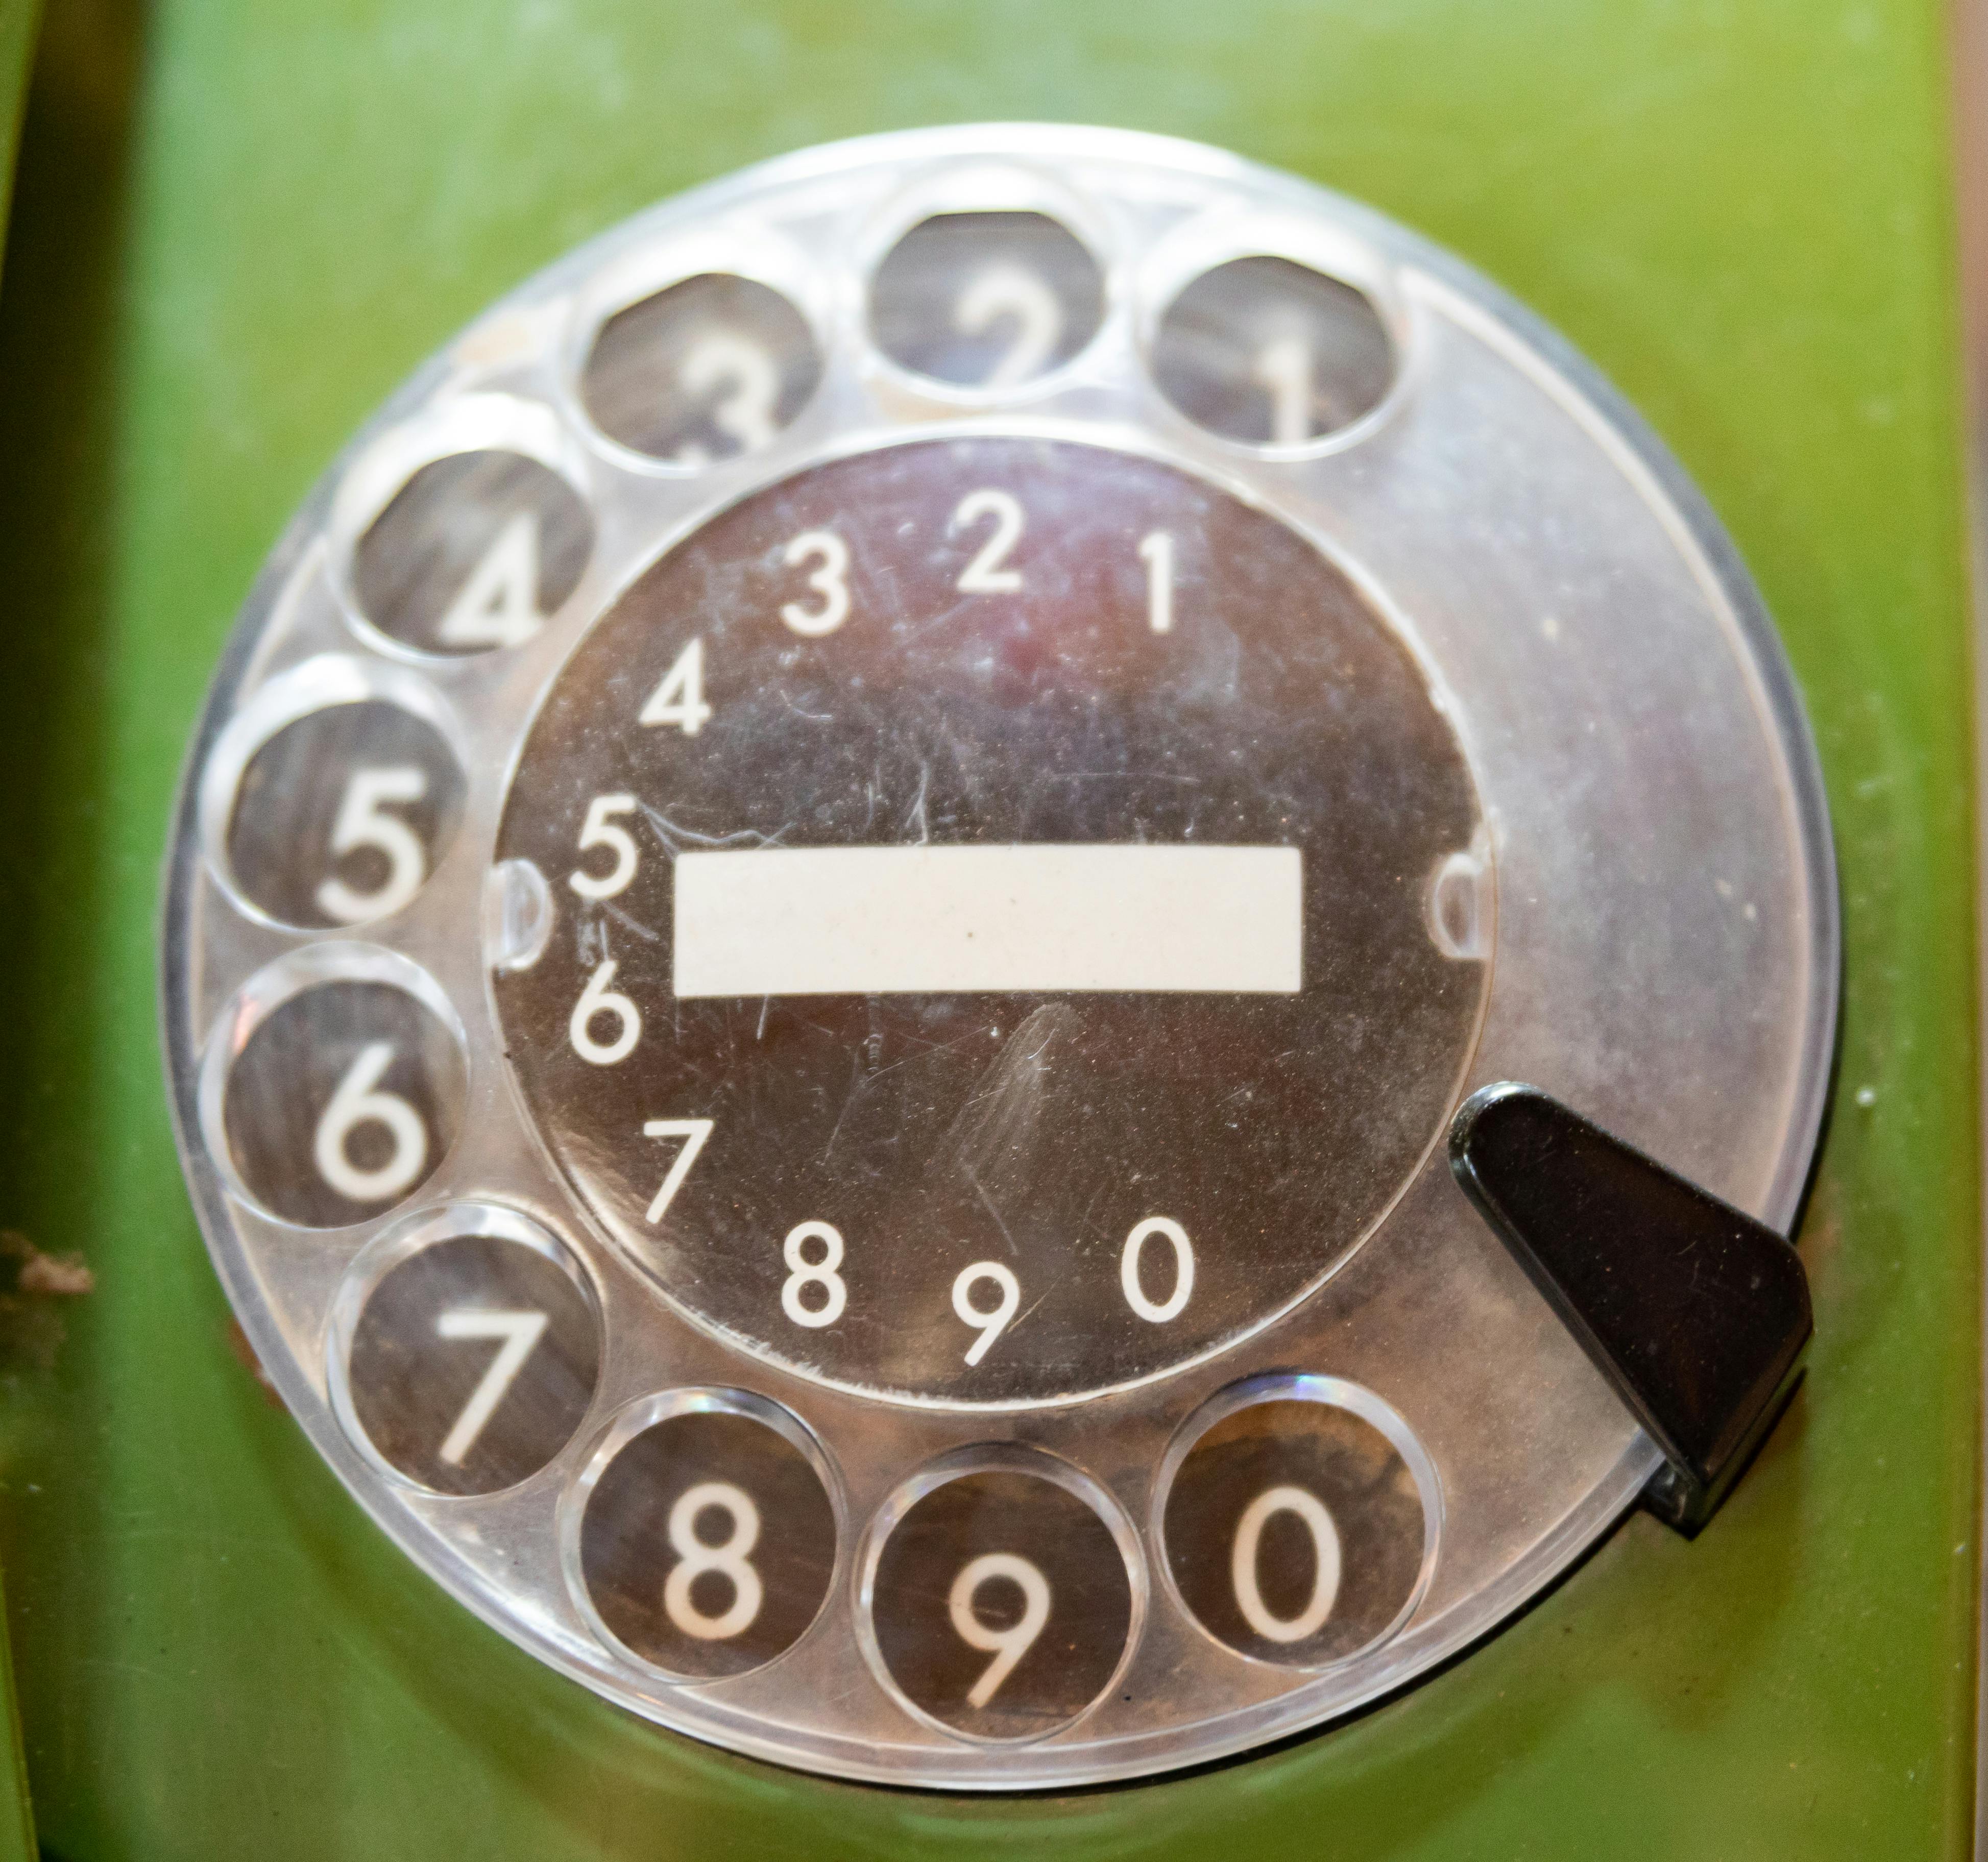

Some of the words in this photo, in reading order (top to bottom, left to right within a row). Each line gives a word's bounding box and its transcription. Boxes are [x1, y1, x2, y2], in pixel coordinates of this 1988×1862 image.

[953, 264, 1063, 387] 2
[1258, 323, 1312, 442] 1
[679, 332, 779, 464] 3
[440, 519, 546, 643] 4
[781, 532, 851, 635] 3
[952, 490, 1025, 594] 2
[1138, 529, 1178, 632] 1
[639, 638, 711, 735] 4
[317, 768, 426, 923] 5
[570, 793, 639, 902] 5
[569, 955, 641, 1064] 6
[313, 1041, 425, 1199] 6
[644, 1119, 715, 1227] 7
[781, 1221, 847, 1329] 8
[951, 1261, 1020, 1366] 9
[1120, 1217, 1197, 1324] 0
[434, 1308, 548, 1464] 7
[665, 1482, 762, 1639] 8
[1233, 1486, 1341, 1644] 0
[950, 1554, 1051, 1709] 9
